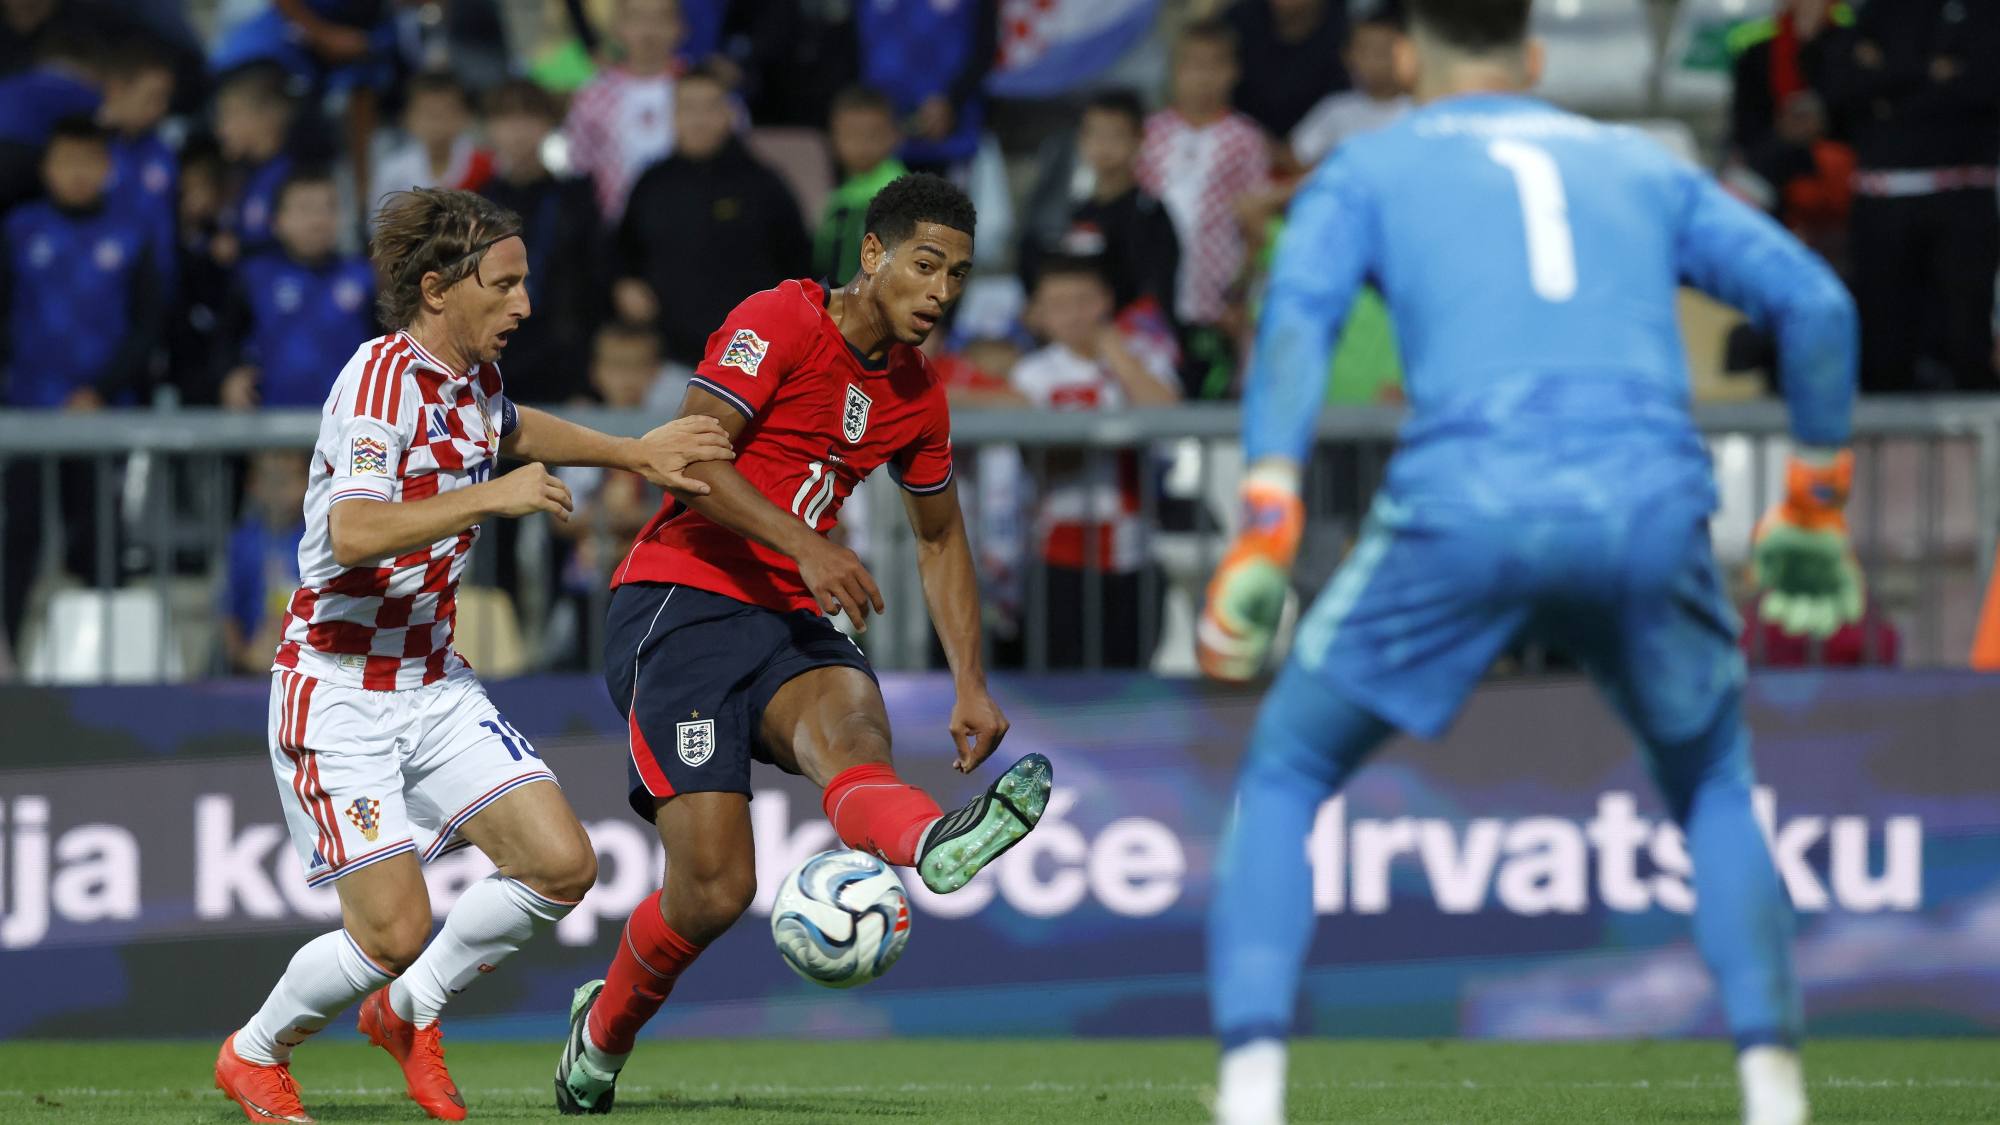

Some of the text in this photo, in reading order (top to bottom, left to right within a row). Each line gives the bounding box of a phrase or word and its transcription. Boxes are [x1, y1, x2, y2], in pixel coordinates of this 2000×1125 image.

[1488, 138, 1577, 302] 1
[792, 461, 836, 529] 10
[0, 794, 141, 949] ja
